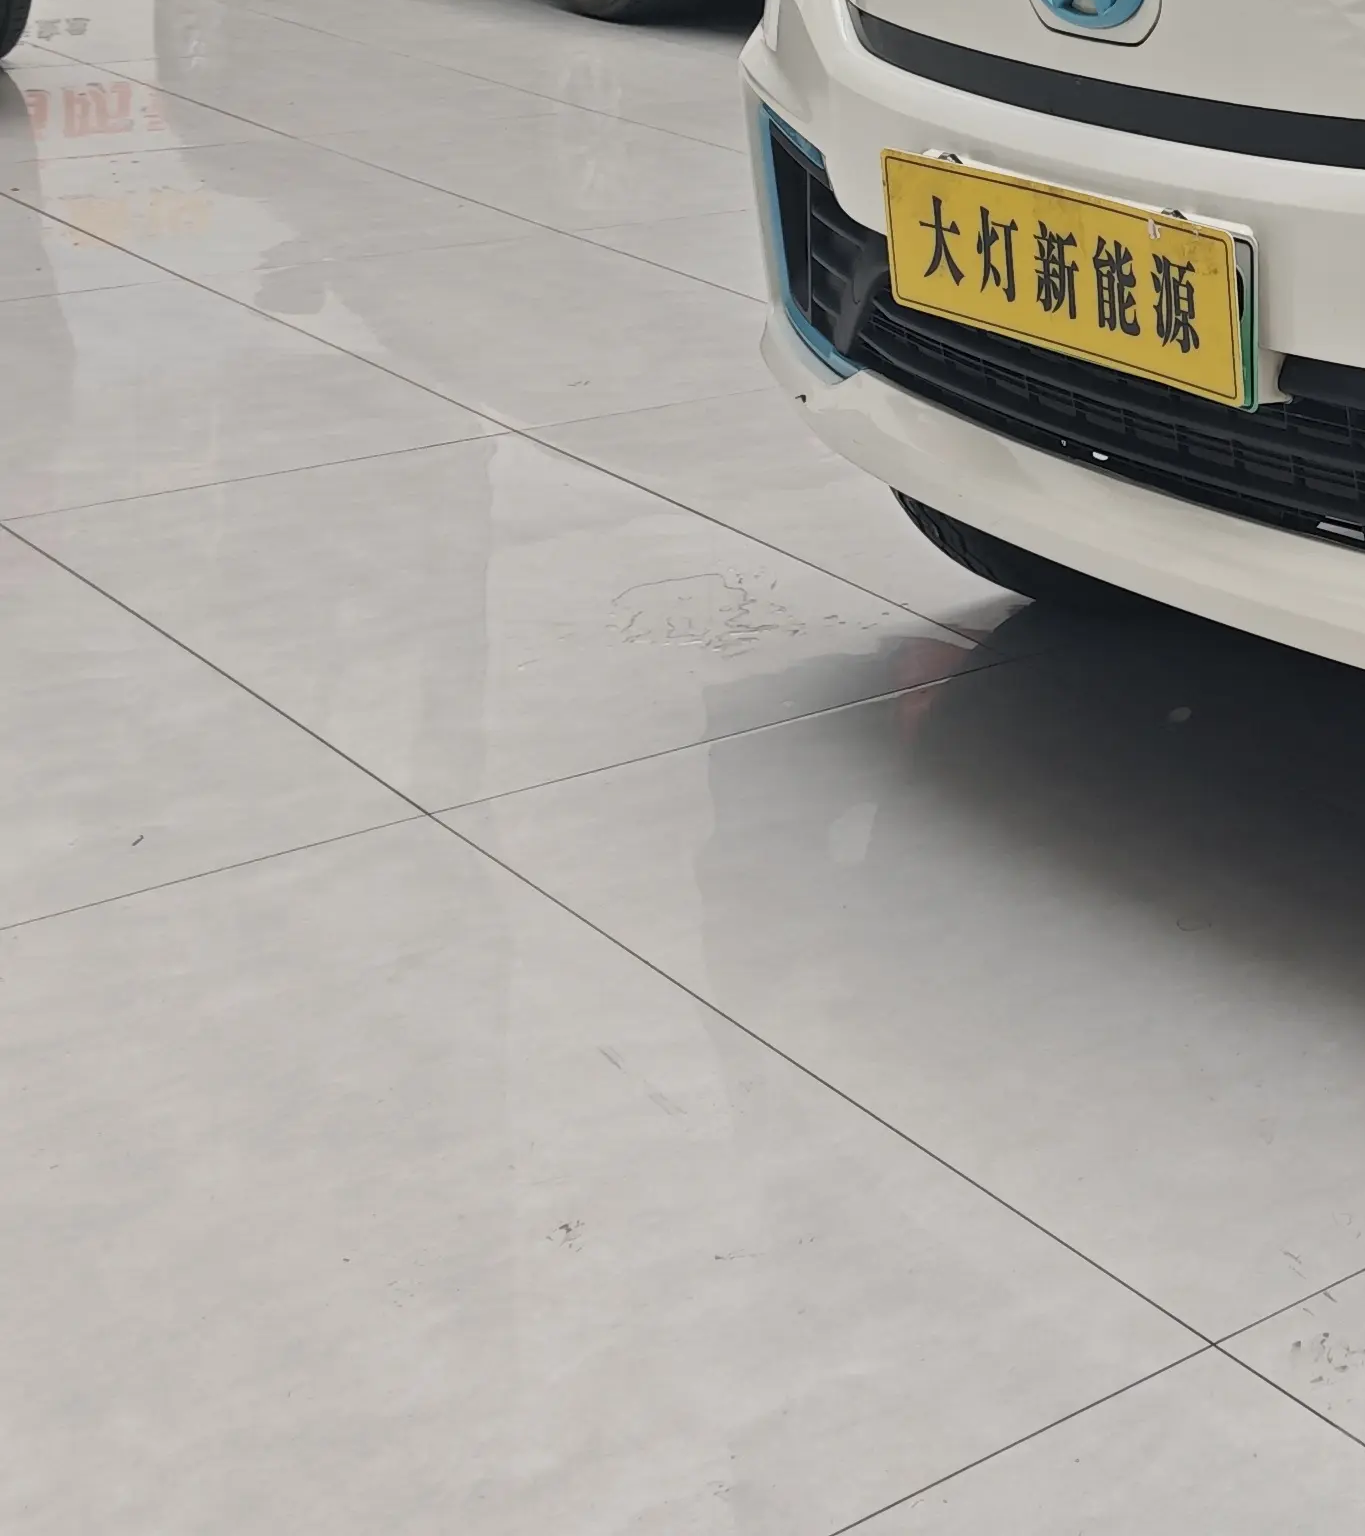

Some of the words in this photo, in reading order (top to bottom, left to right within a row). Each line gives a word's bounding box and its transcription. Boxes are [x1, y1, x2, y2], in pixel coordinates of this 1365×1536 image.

[918, 193, 1201, 354] 大灯新能源
